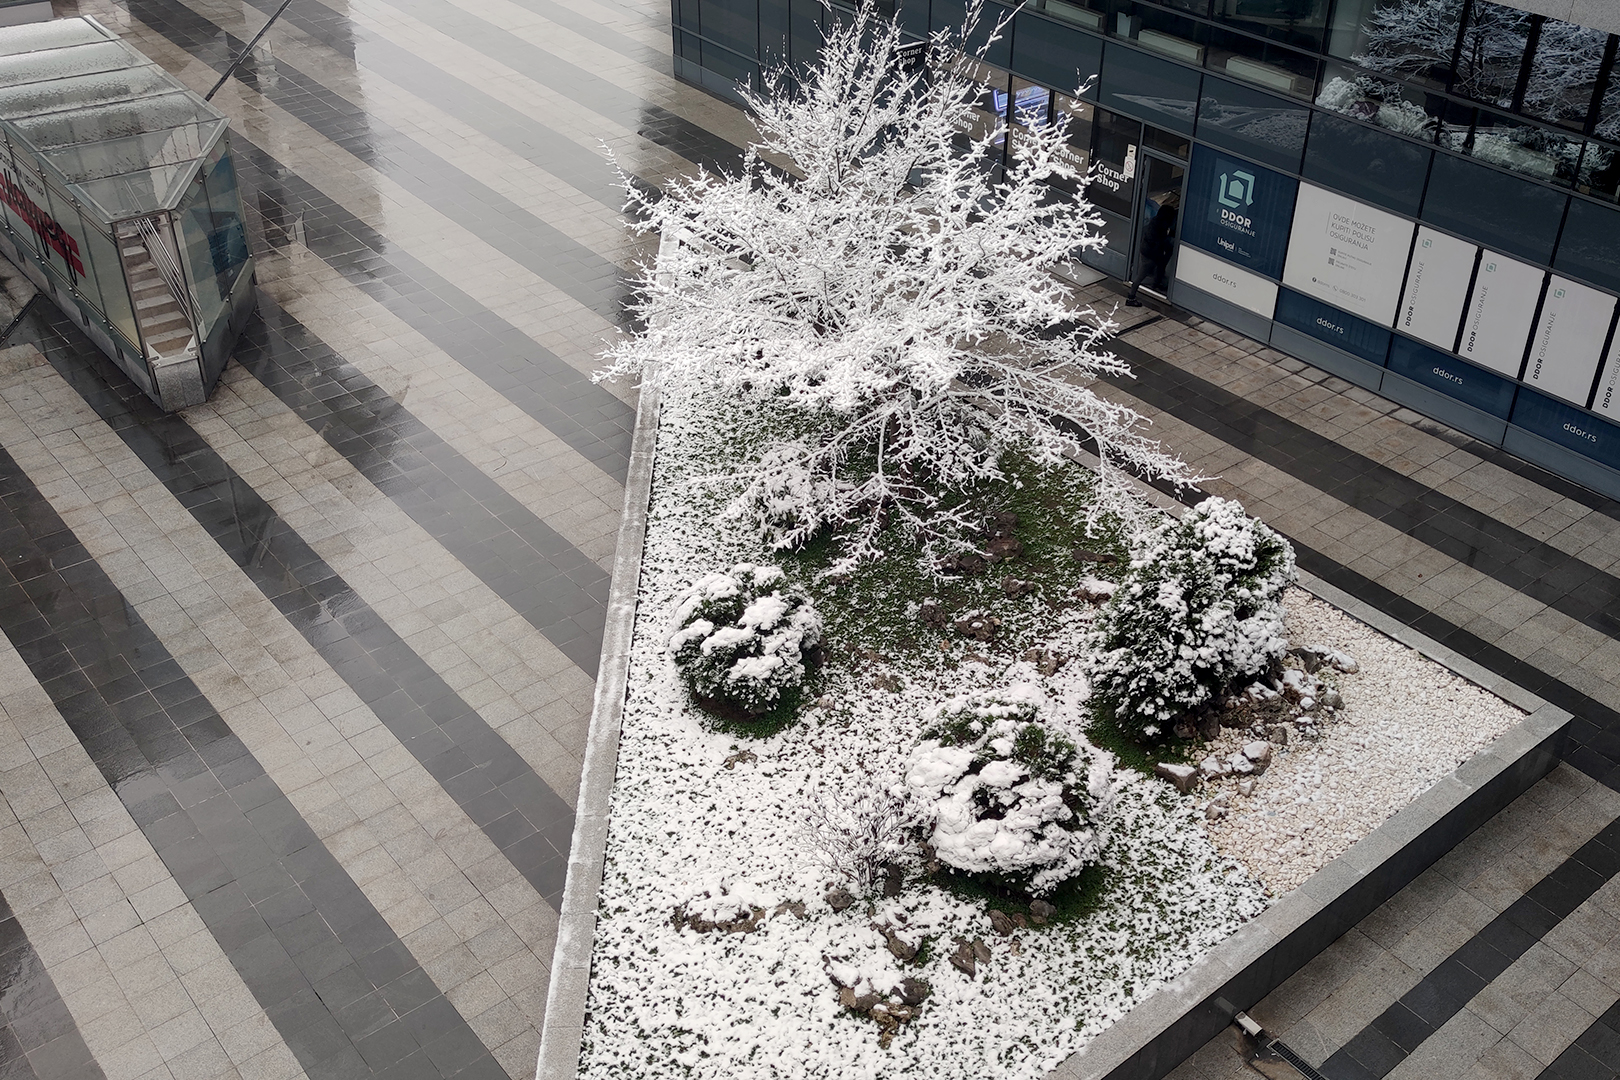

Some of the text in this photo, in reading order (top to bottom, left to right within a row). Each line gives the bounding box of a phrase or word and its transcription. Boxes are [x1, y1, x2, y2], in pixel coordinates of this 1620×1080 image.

[1098, 163, 1129, 183] Corner
[1097, 174, 1119, 192] Shop
[1220, 219, 1256, 237] OSIGURANJE
[1221, 209, 1252, 228] DDOR
[1333, 213, 1350, 225] OVDE
[1329, 231, 1369, 250] OSIGURANJA
[1331, 222, 1375, 243] KUPITI POLISU
[1212, 272, 1237, 288] ddor.rs
[1405, 261, 1425, 327] DDOR OSIGURANJE
[1316, 316, 1344, 335] ddor.rs
[1467, 286, 1489, 352] DDOR OSIGURANJE
[1532, 311, 1557, 380] DDOR OSIGURANJE
[1432, 366, 1464, 385] ddor.rs
[1602, 386, 1614, 409] DDOR
[1562, 422, 1598, 443] ddor.rs
